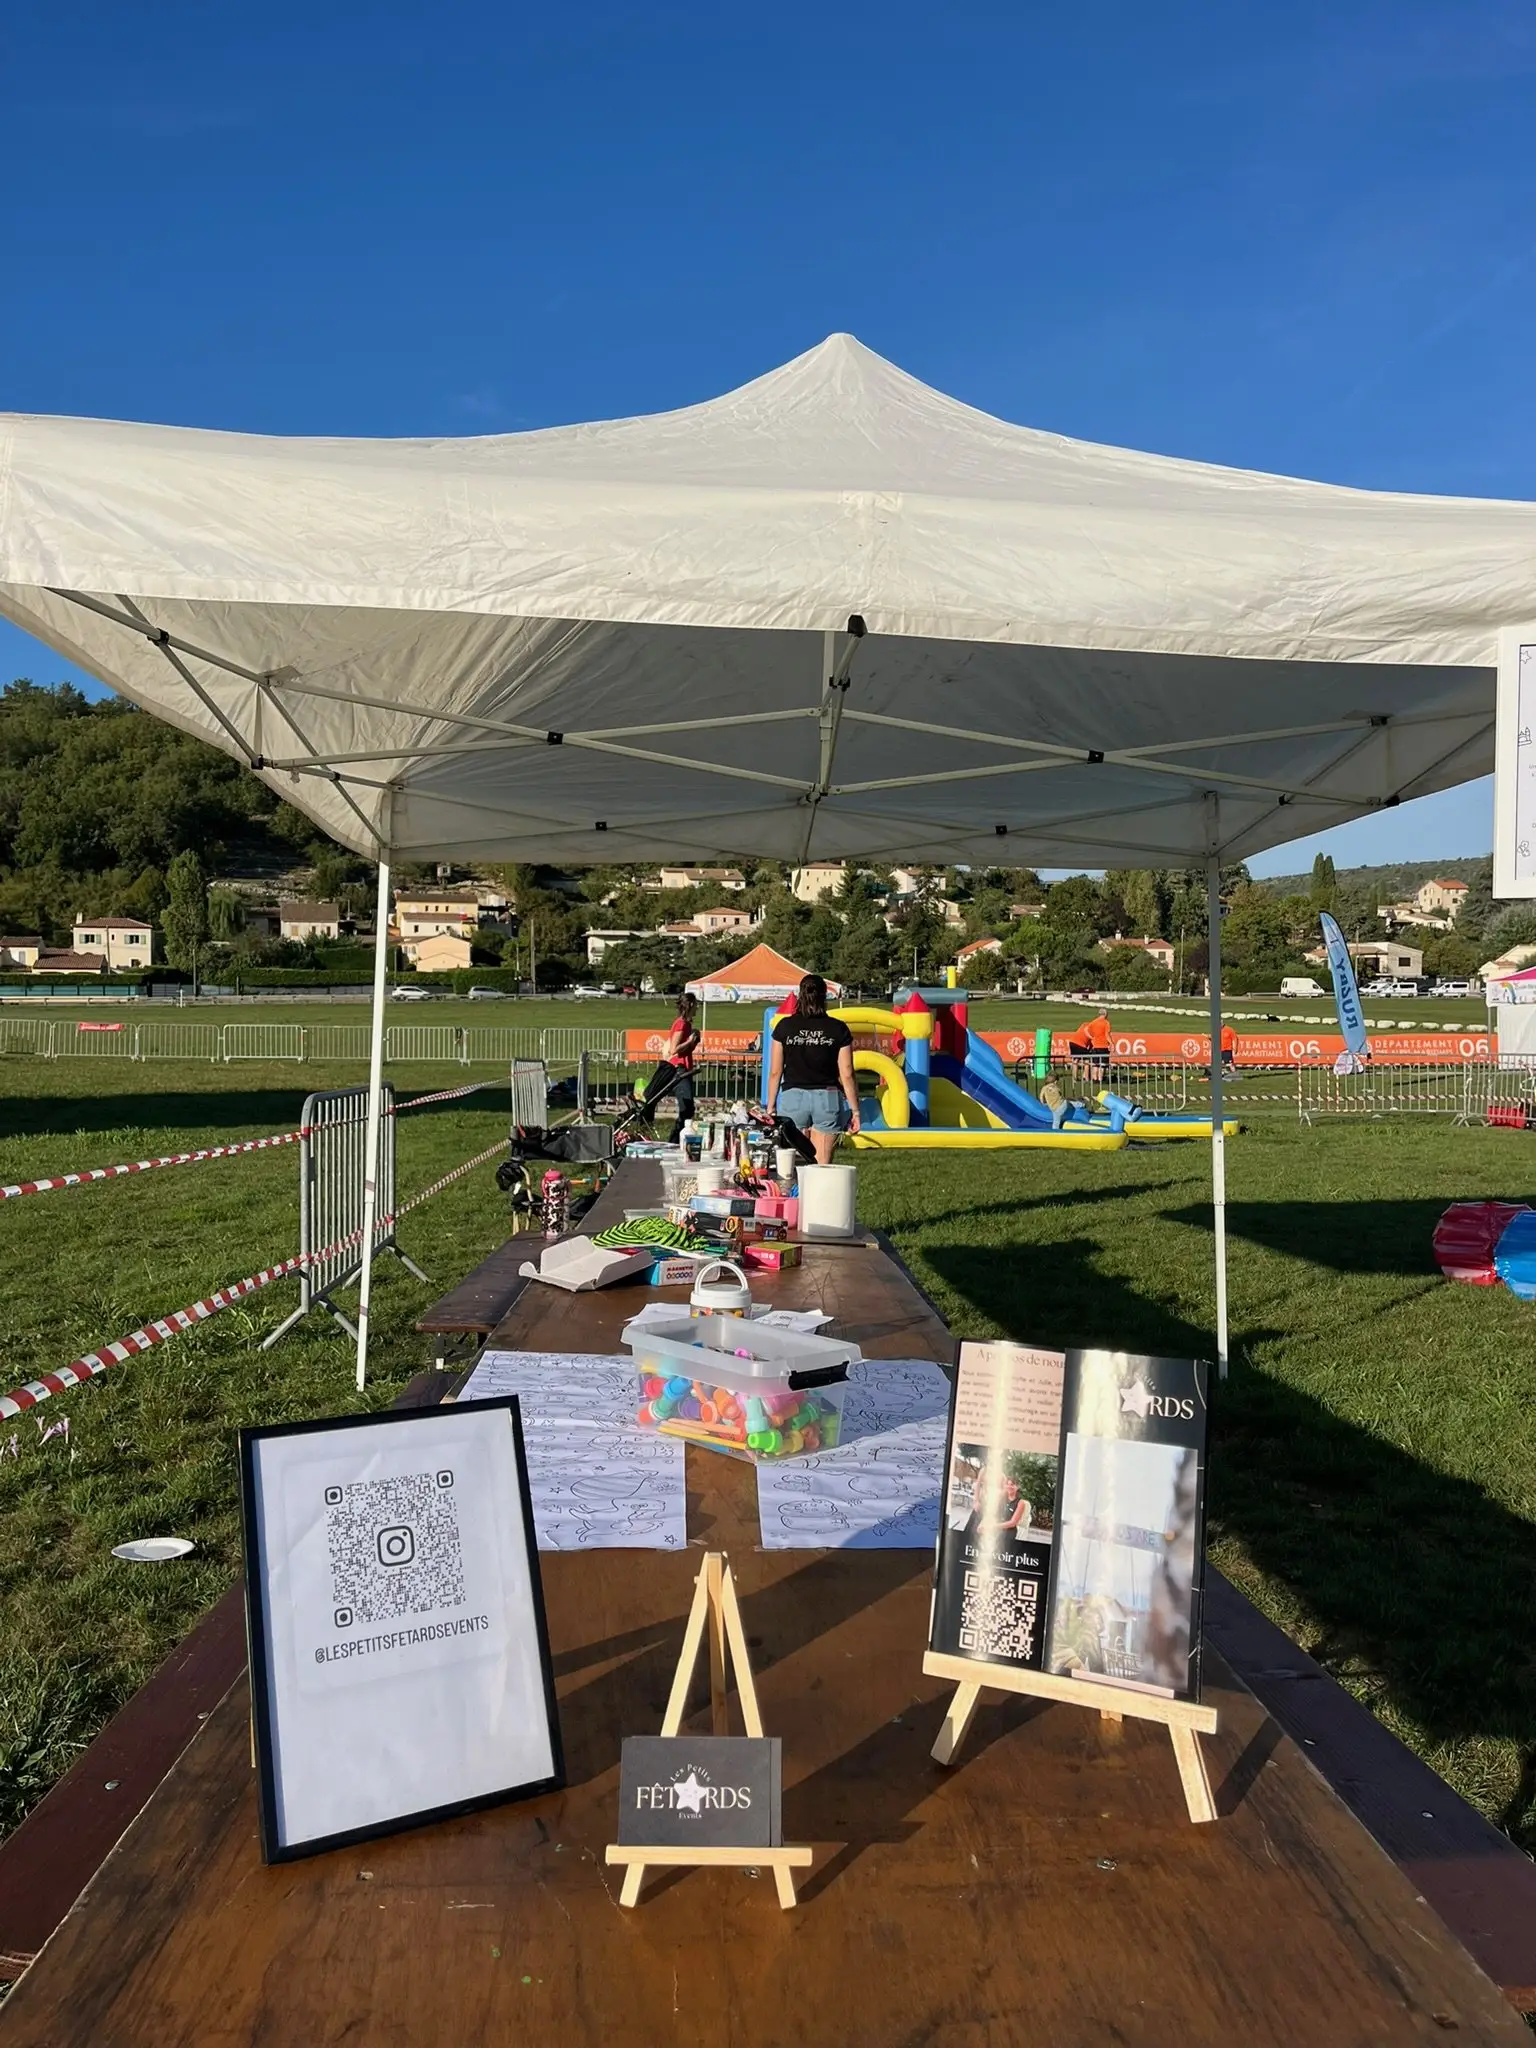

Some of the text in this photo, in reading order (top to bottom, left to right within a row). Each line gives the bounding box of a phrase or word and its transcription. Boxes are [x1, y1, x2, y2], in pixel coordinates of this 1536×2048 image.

[799, 1029, 824, 1037] STAFF
[1115, 1038, 1147, 1056] 06
[1289, 1039, 1321, 1059] 06
[1459, 1038, 1489, 1057] 06
[1026, 1354, 1041, 1366] de
[1042, 1358, 1065, 1369] nou
[964, 1544, 979, 1557] En
[1015, 1553, 1039, 1567] plus
[314, 1615, 489, 1664] @LESPETITSFETARDSEVENTS
[636, 1782, 751, 1809] FÊTRDS
[678, 1812, 703, 1820] Events
